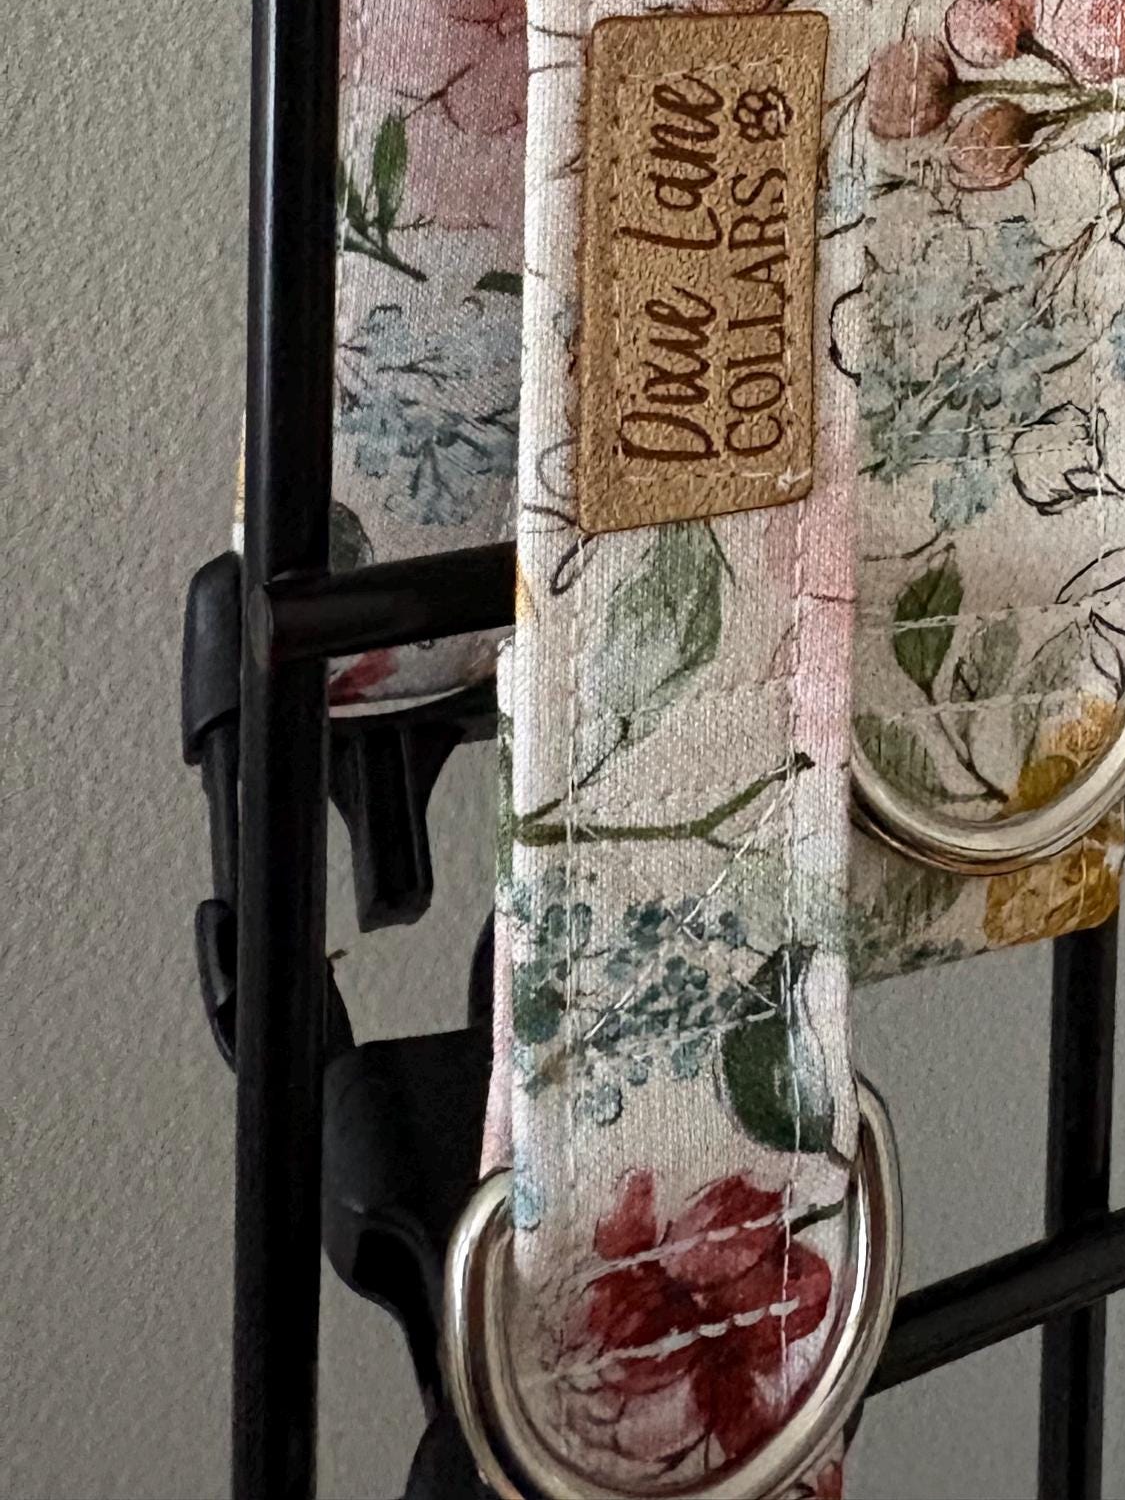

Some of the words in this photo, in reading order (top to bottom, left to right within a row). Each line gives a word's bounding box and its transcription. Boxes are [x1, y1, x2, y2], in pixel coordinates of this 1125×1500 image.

[618, 72, 724, 250] Lane
[612, 286, 720, 461] Dixie
[725, 167, 789, 456] COLLARS
